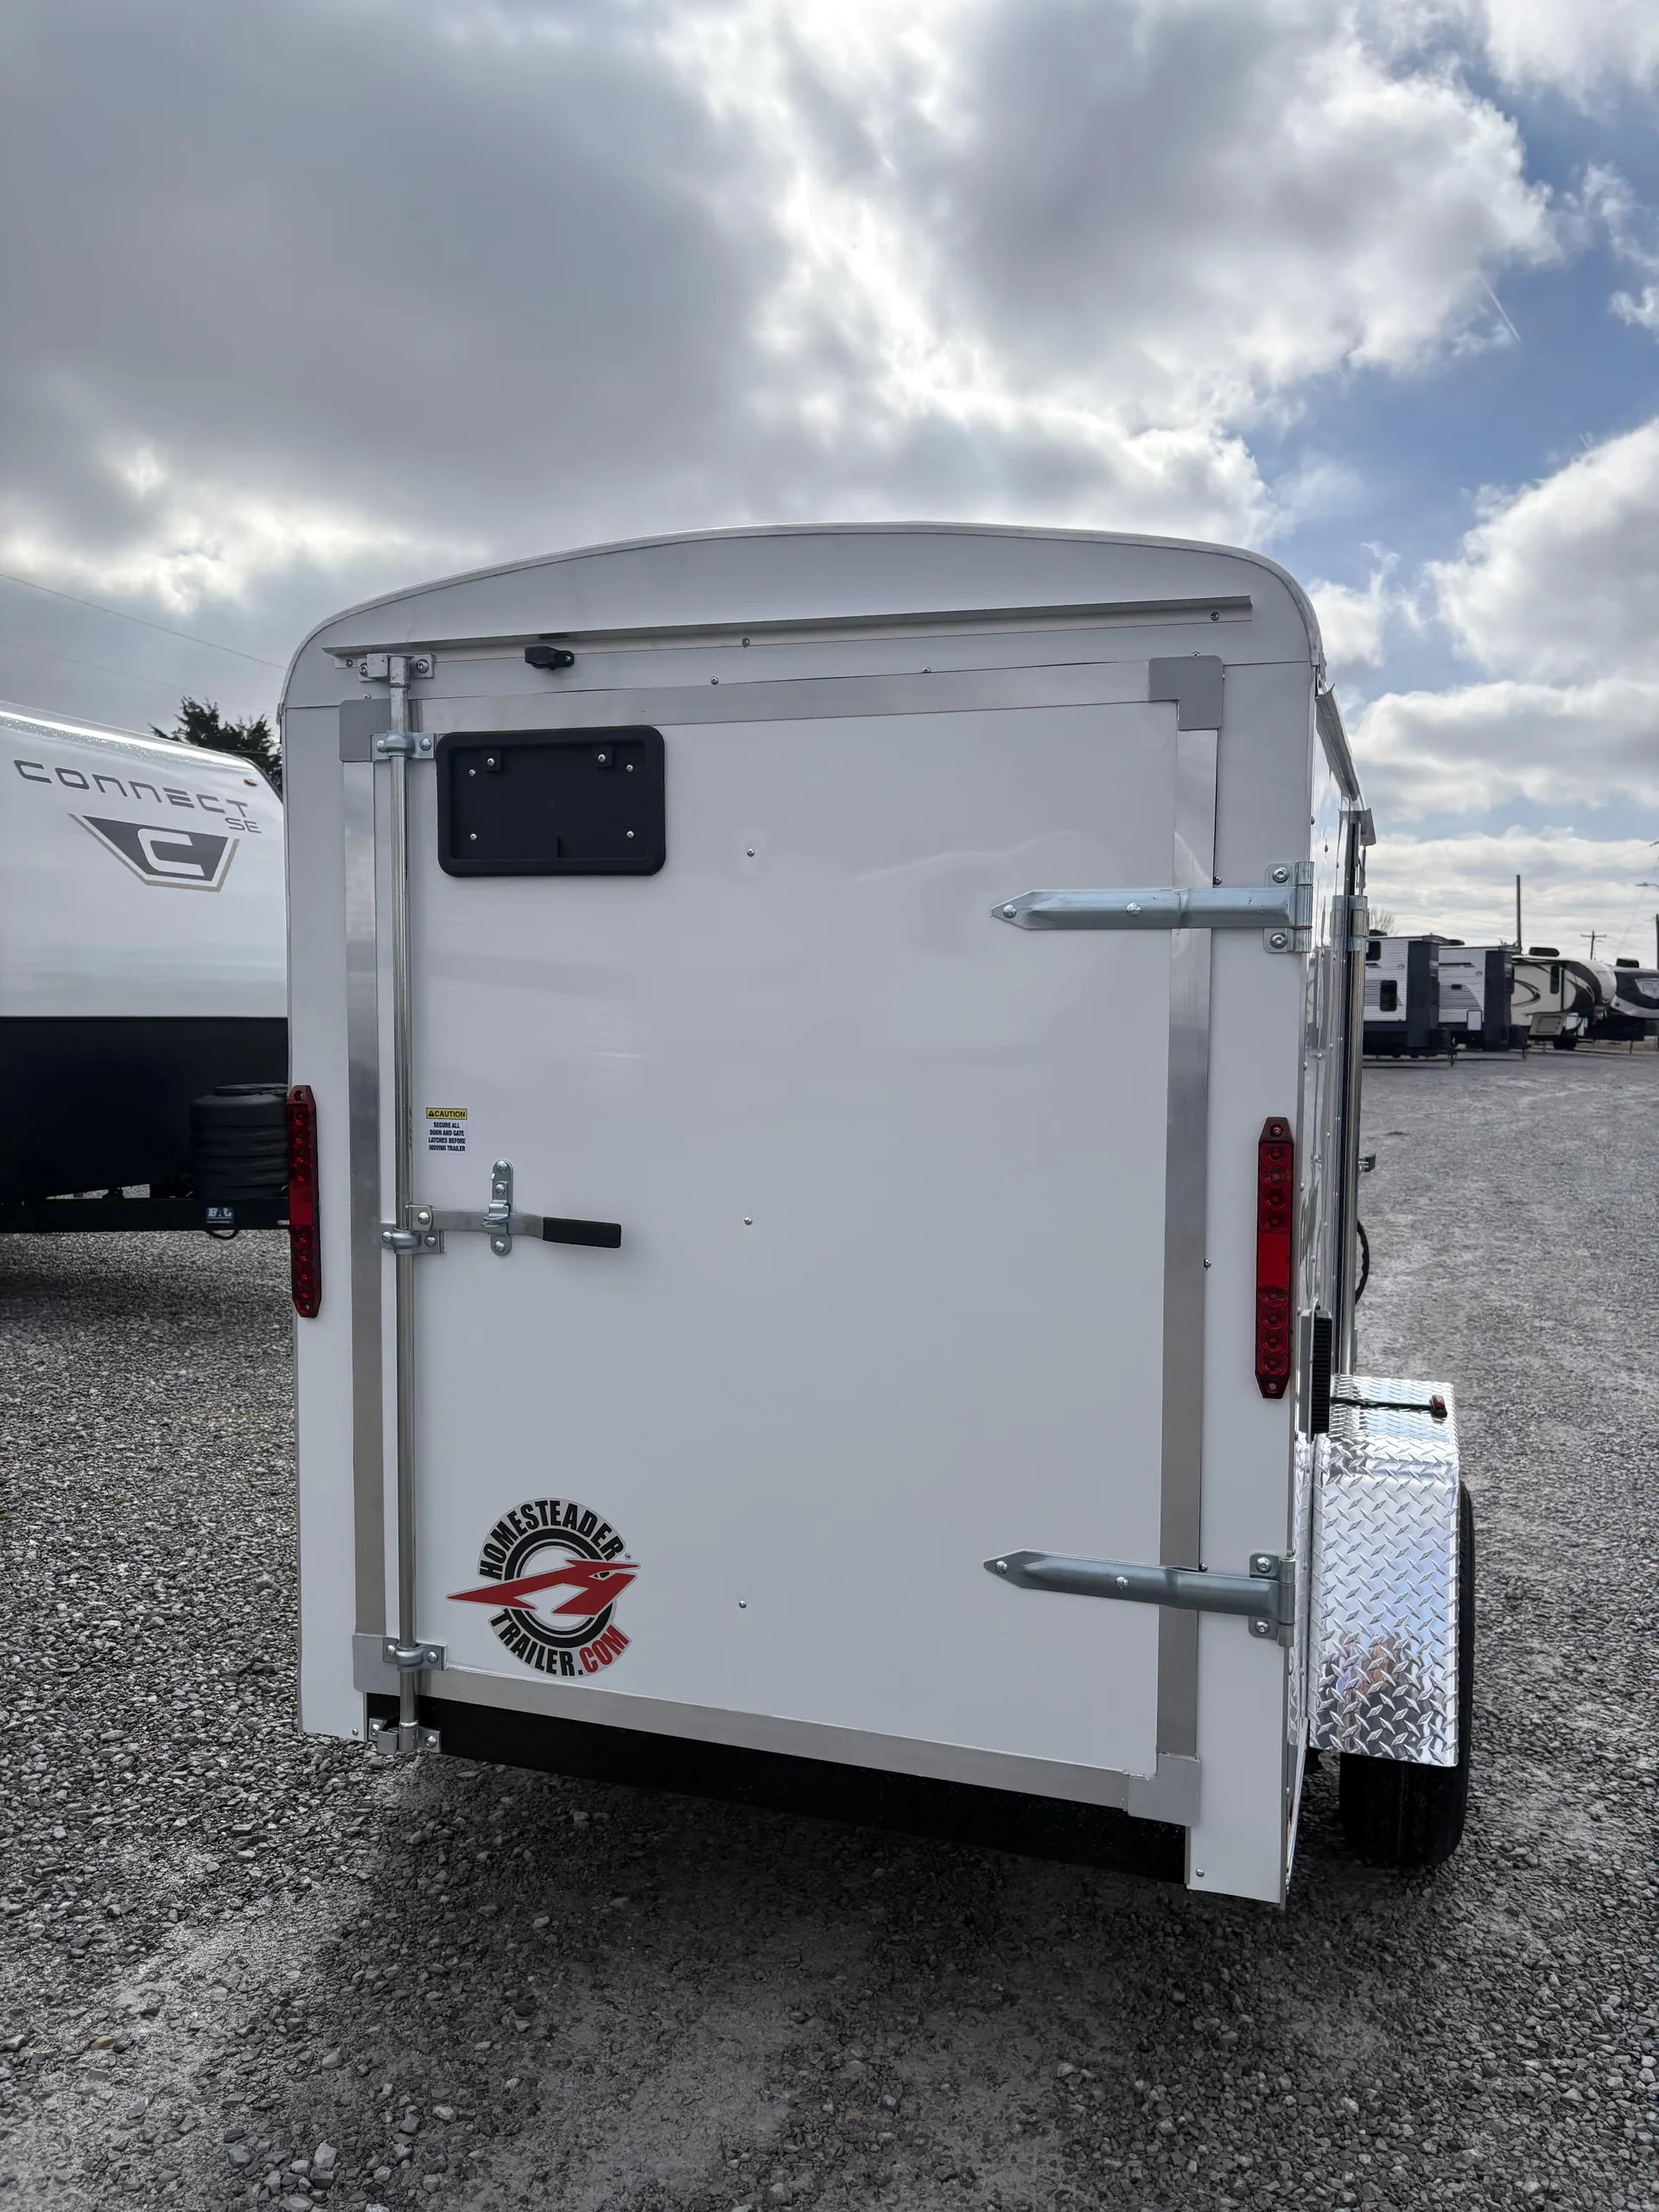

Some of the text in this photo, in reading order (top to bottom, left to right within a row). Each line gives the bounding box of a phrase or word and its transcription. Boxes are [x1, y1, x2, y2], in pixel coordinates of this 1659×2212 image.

[14, 760, 249, 817] CONNECT
[225, 817, 262, 834] SE
[479, 1500, 625, 1580] HOMESTEADER
